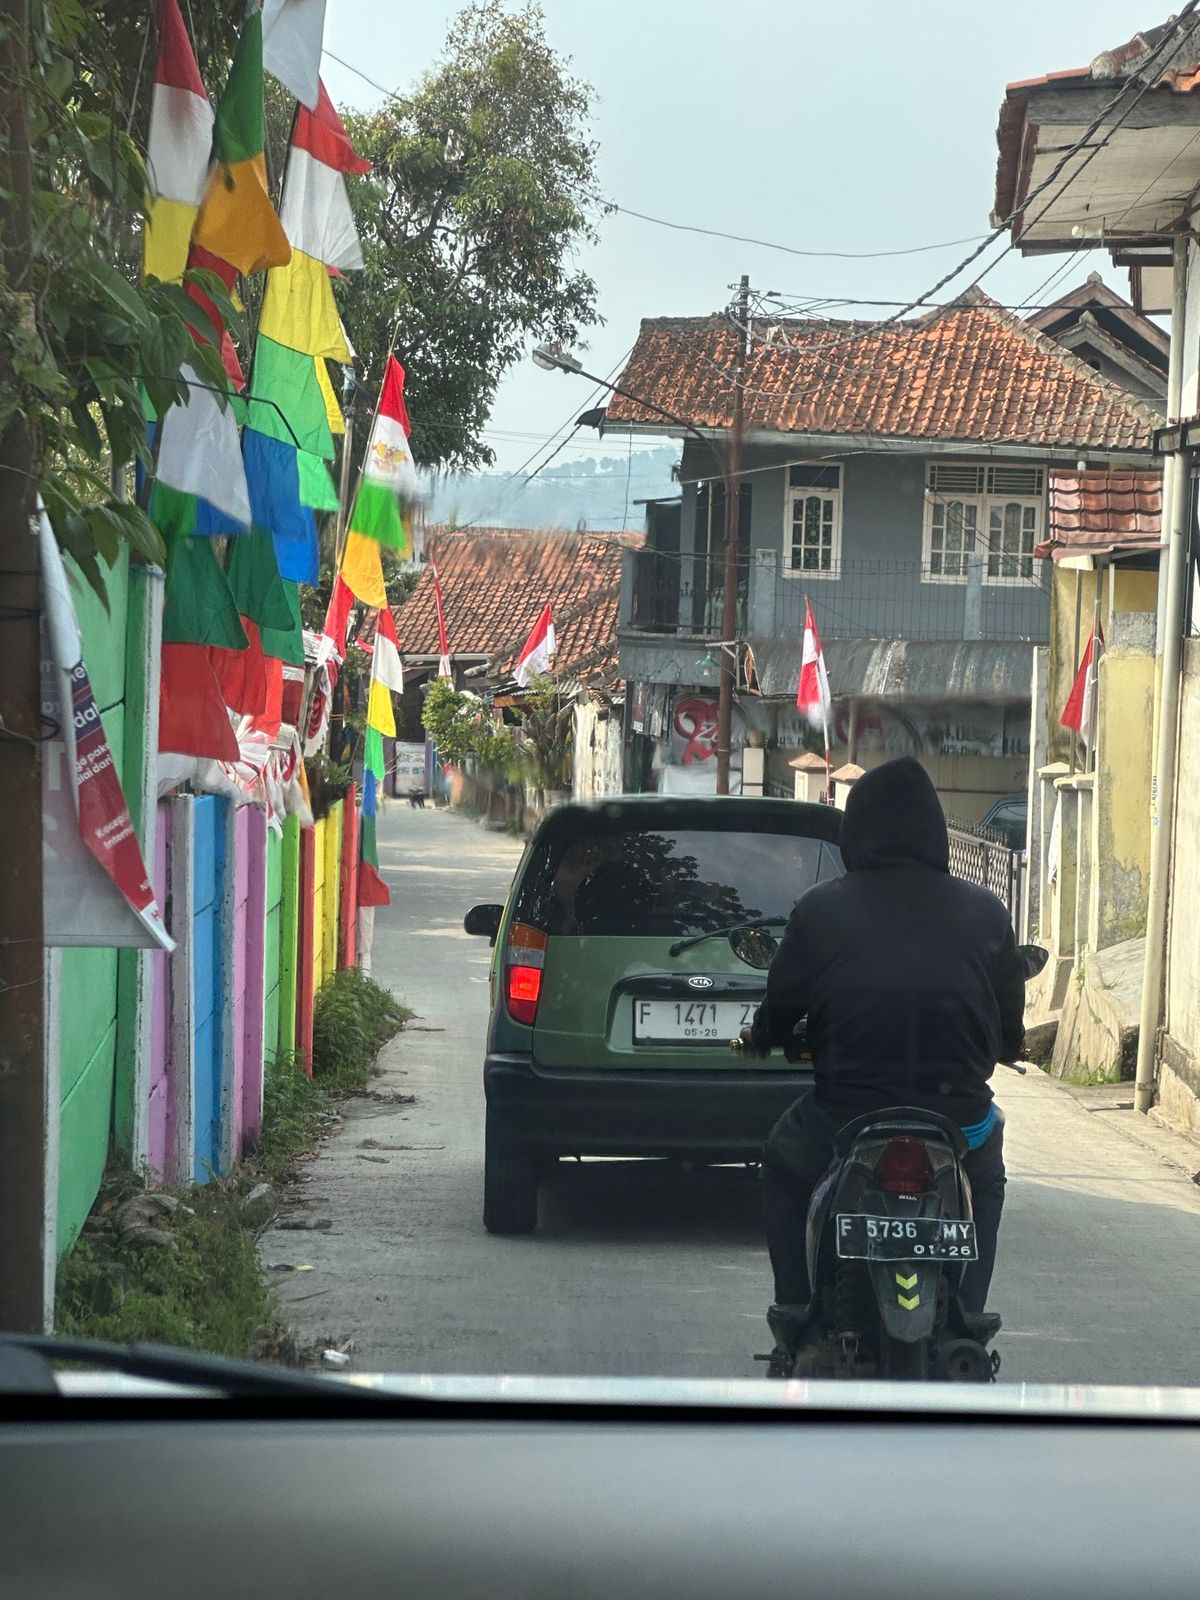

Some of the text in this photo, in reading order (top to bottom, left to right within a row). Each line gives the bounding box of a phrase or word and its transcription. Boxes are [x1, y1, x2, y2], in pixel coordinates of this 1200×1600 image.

[690, 978, 711, 987] KIA
[640, 1003, 651, 1024] F
[675, 1003, 717, 1025] 1471
[841, 1218, 970, 1240] F 5736 MY
